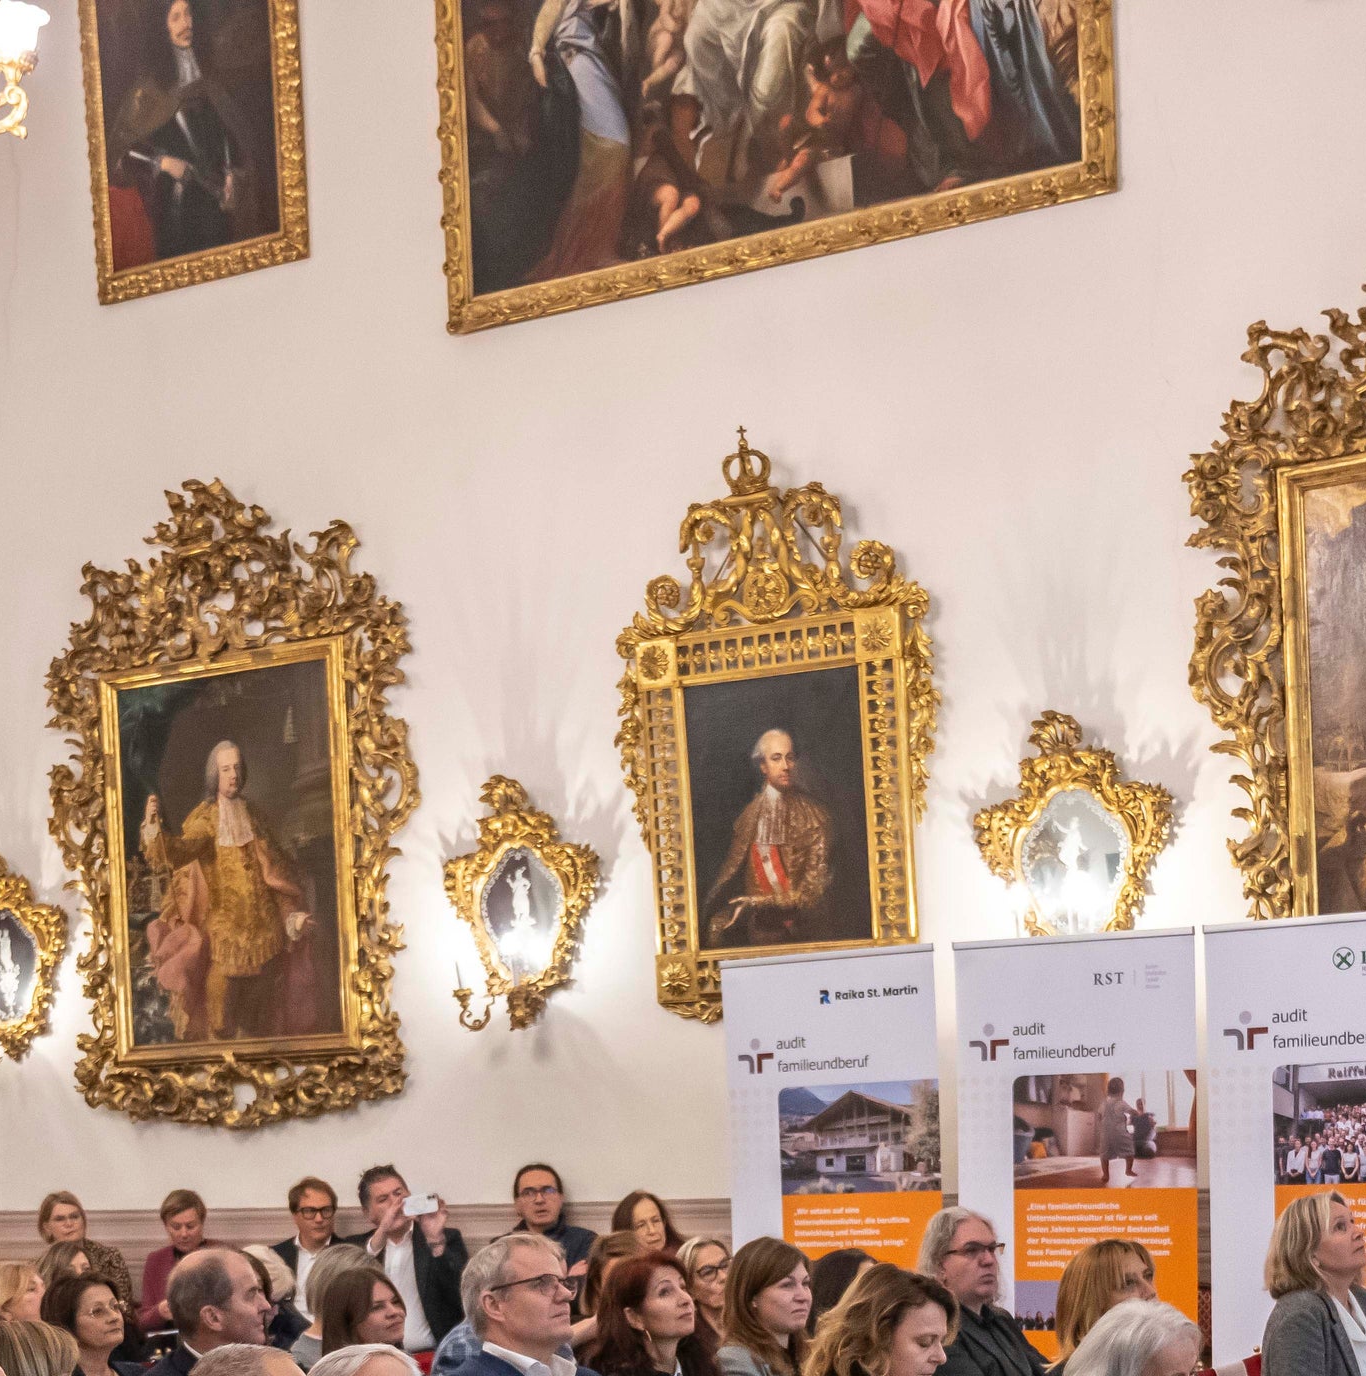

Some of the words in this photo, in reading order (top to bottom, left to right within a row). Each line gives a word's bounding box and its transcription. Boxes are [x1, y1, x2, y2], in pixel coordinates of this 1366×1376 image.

[1093, 972, 1124, 986] RST
[835, 991, 864, 1000] Raika
[867, 988, 881, 998] St.
[883, 985, 918, 997] Martin
[1272, 1009, 1308, 1023] audit
[1012, 1022, 1045, 1036] audit
[776, 1037, 806, 1050] audit
[1013, 1043, 1116, 1060] familieundberuf
[778, 1055, 869, 1072] familieundberuf
[1047, 1202, 1120, 1210] familienfreundliche
[1026, 1214, 1102, 1222] Unternehmenskultur
[1144, 1213, 1158, 1221] seit
[1027, 1225, 1049, 1233] vielen
[1050, 1225, 1075, 1233] Jahren
[1077, 1225, 1125, 1233] wesentlicher
[1127, 1225, 1169, 1233] Bestandteil
[1026, 1237, 1039, 1245] der
[1027, 1248, 1044, 1256] dass
[1045, 1248, 1072, 1256] Familie
